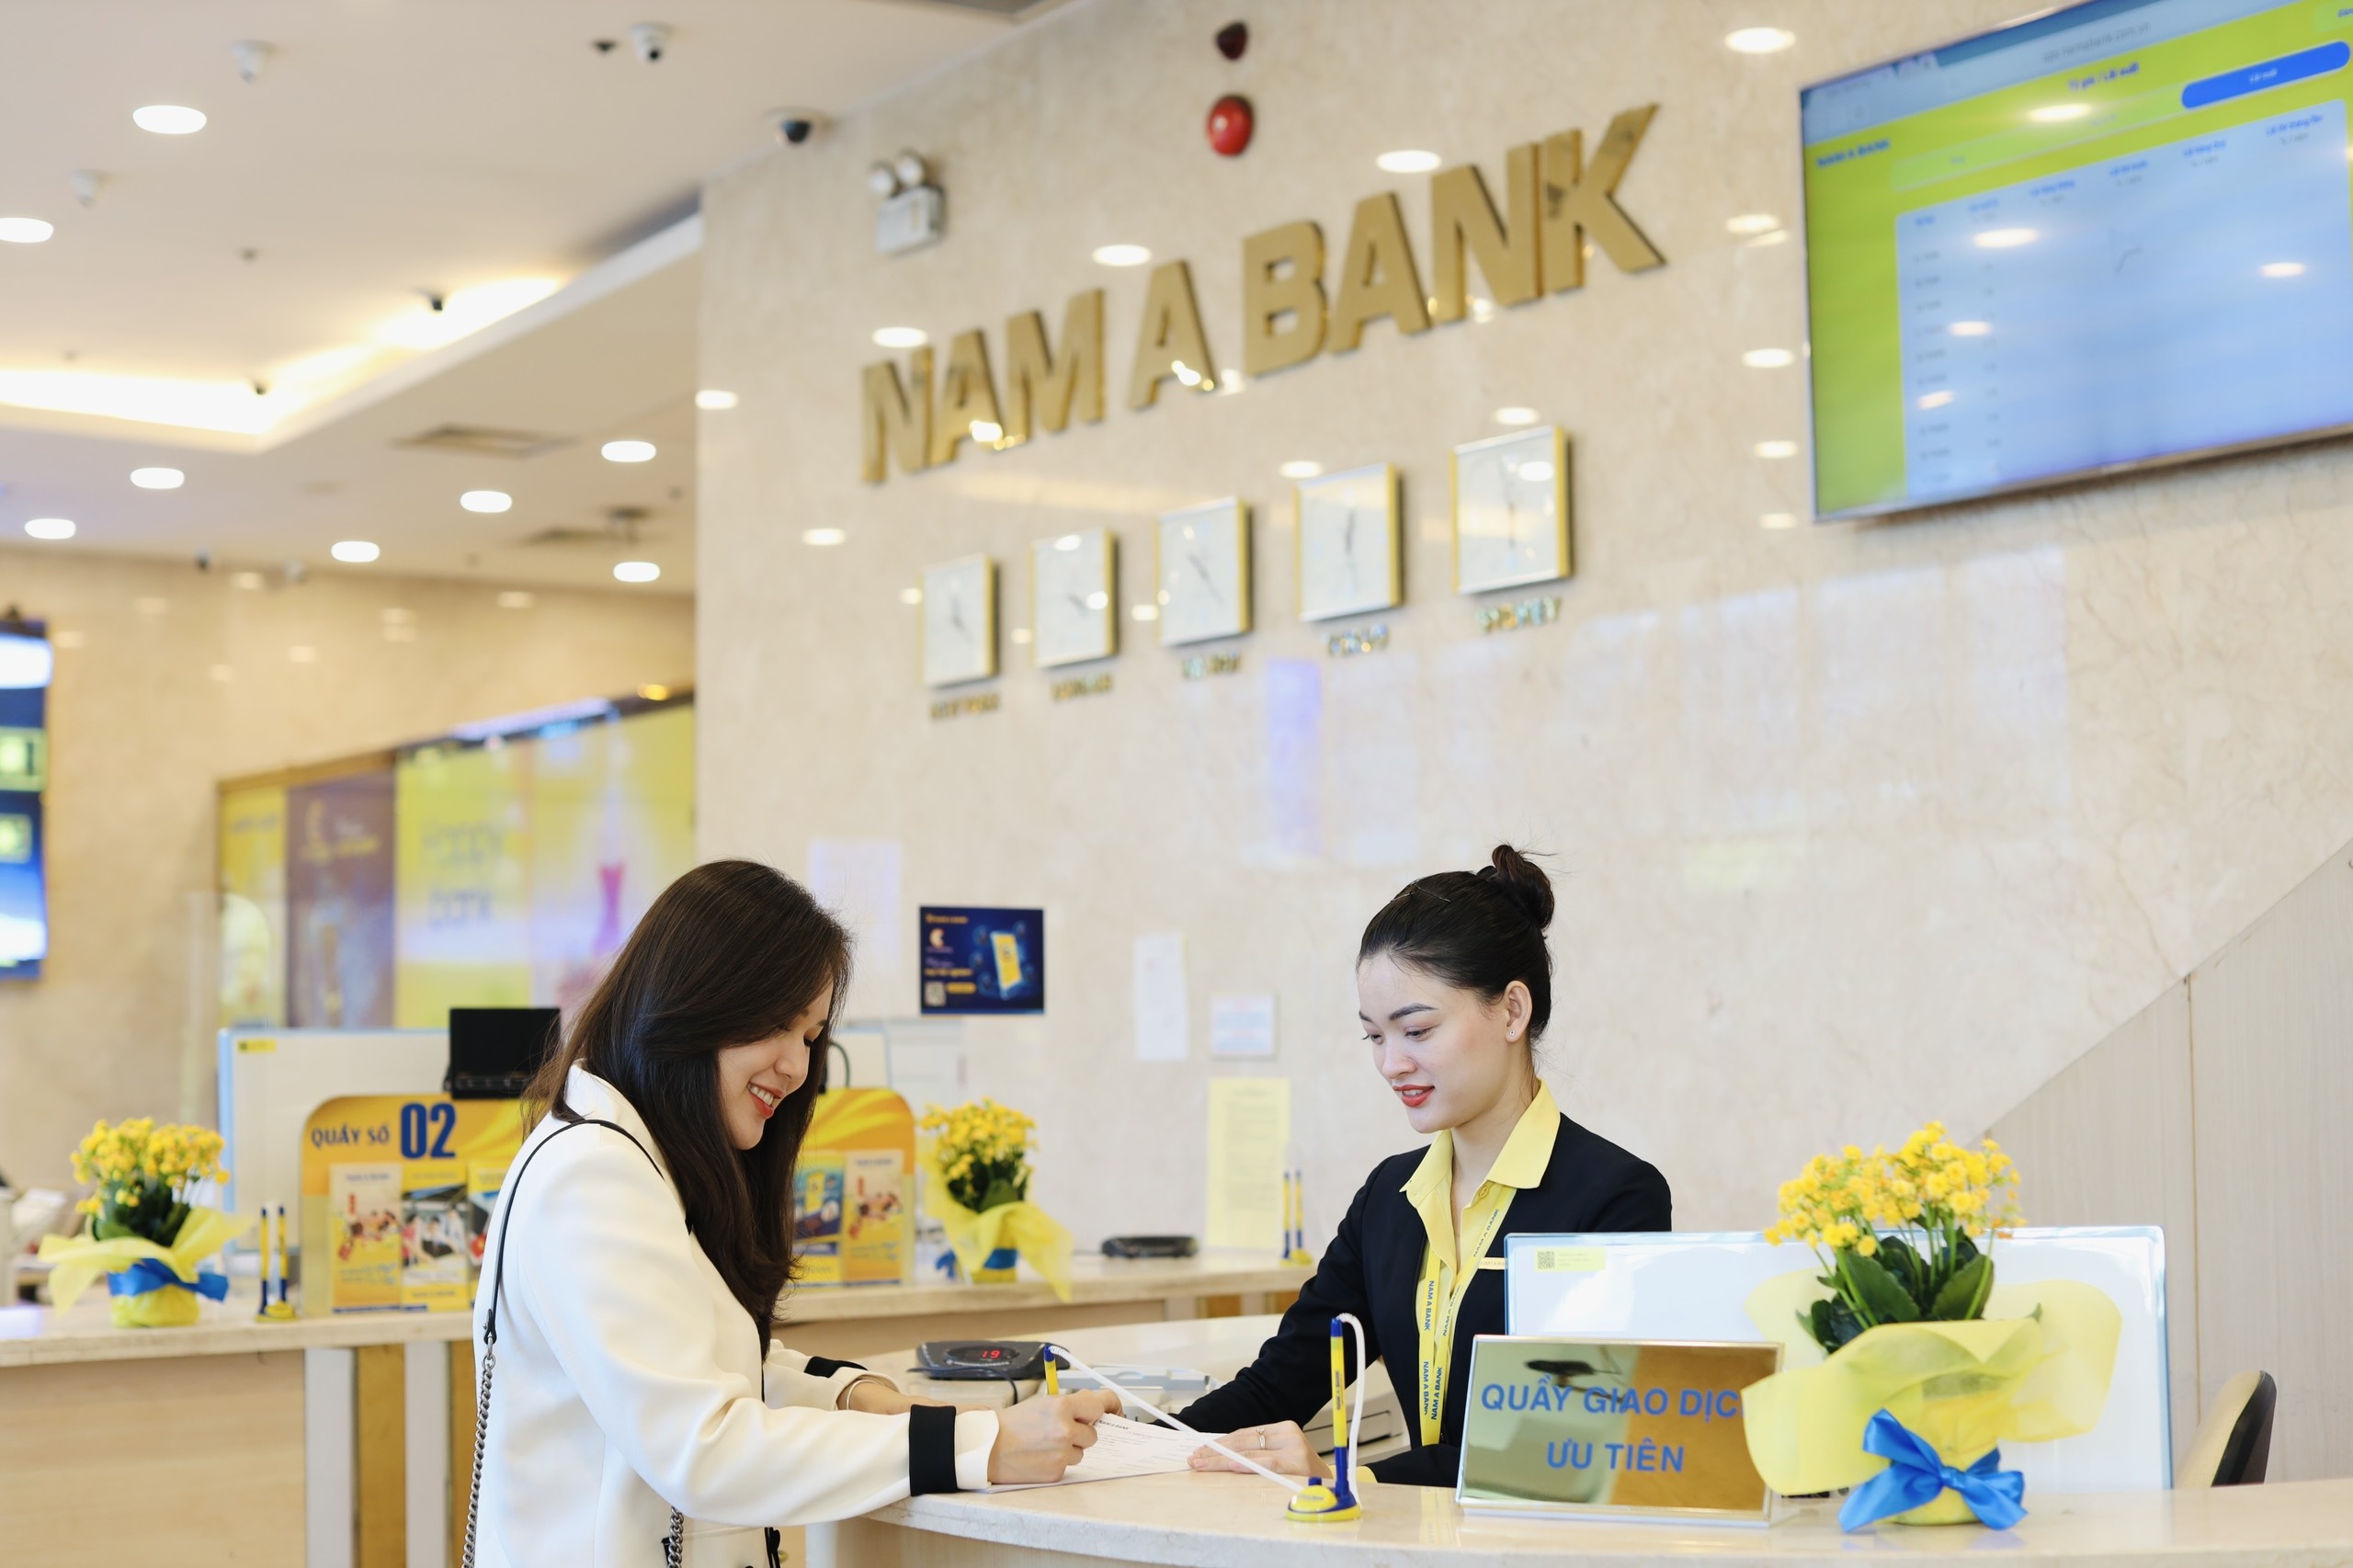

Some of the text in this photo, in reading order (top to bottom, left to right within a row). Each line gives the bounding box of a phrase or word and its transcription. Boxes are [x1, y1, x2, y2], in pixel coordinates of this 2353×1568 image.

[860, 103, 1666, 483] NAM A BANK
[401, 1103, 456, 1159] 02
[1472, 1238, 1484, 1257] NAM
[1486, 1209, 1499, 1232] BANK
[1424, 1307, 1432, 1331] BANK
[982, 1349, 1000, 1358] 19
[1482, 1372, 1745, 1423] QUẦY GIAO DỊC
[1547, 1437, 1685, 1472] ƯU TIÊN
